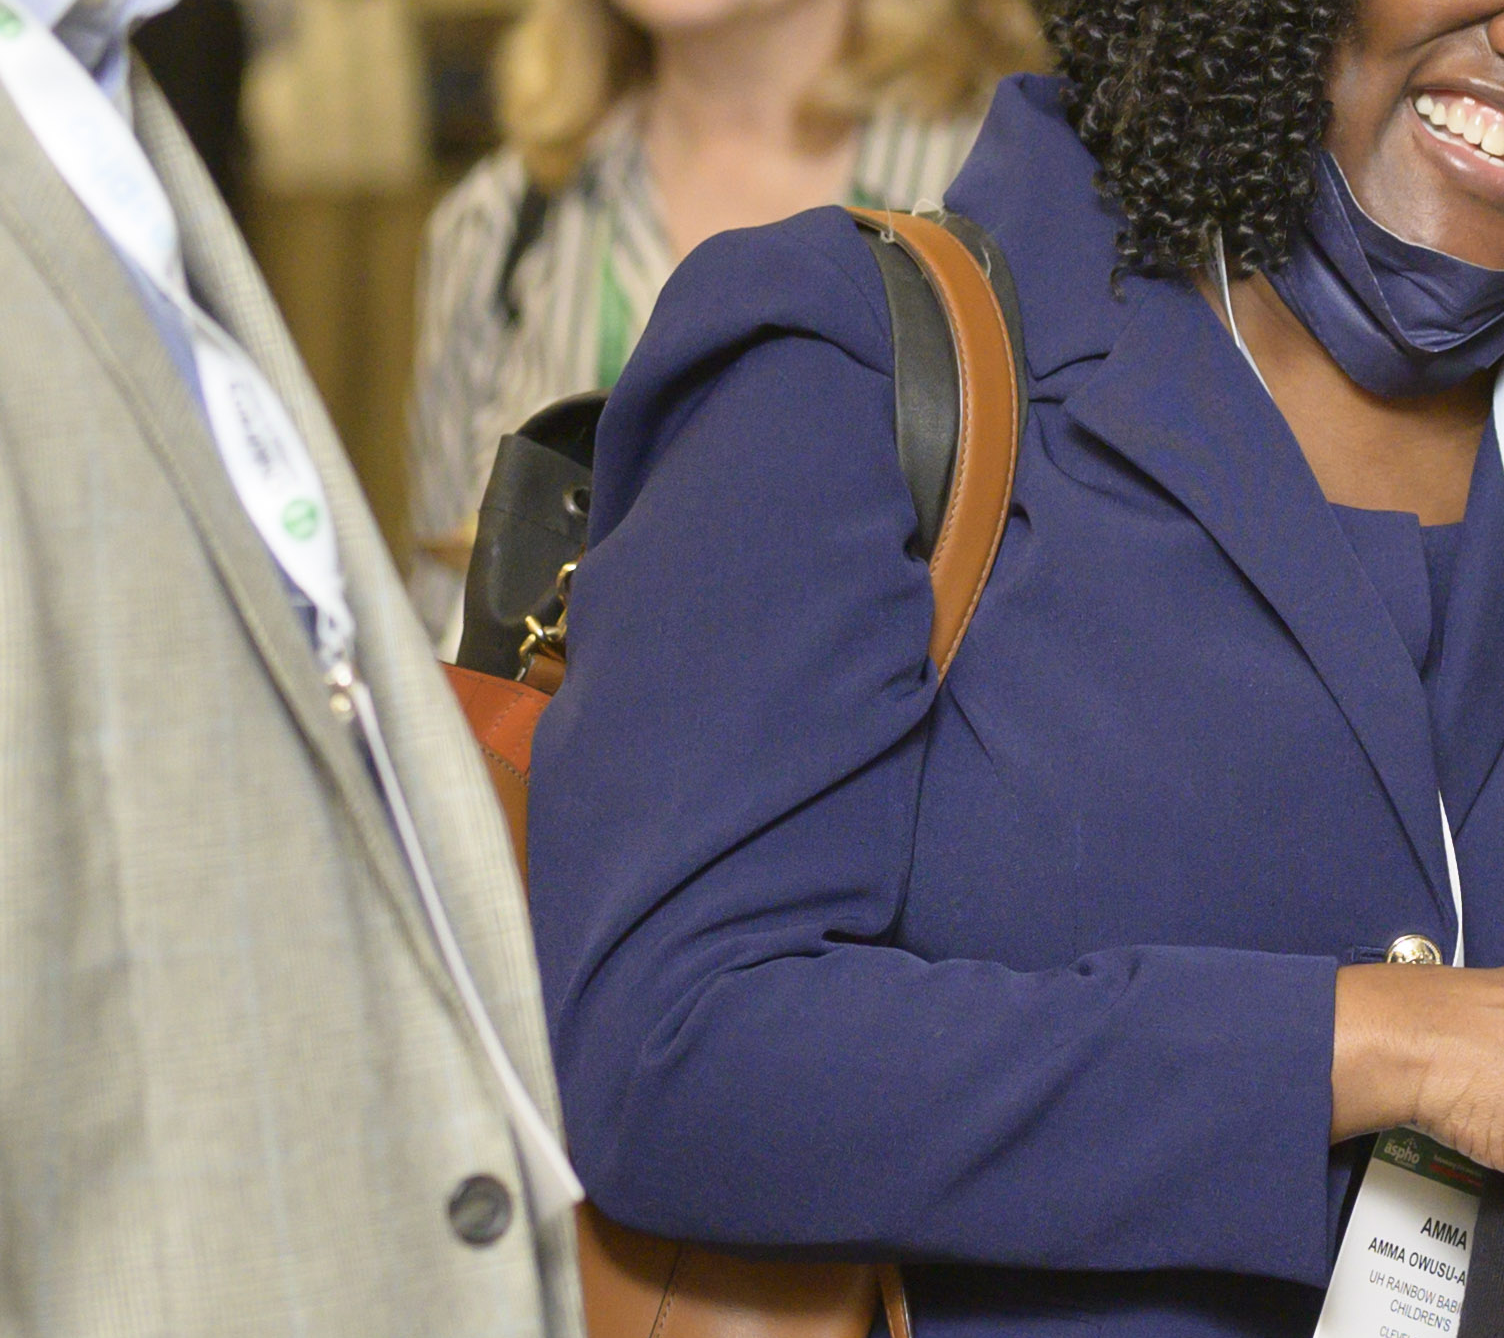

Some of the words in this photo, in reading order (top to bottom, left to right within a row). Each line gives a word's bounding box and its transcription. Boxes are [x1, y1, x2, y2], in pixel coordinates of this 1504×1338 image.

[1383, 1141, 1420, 1165] aspho
[1420, 1216, 1468, 1252] AMMA
[1367, 1236, 1406, 1264] AMMA
[1408, 1251, 1467, 1287] OWUSU-A
[1369, 1269, 1385, 1287] UH
[1385, 1275, 1436, 1305] RAINBOW
[1436, 1293, 1462, 1316] BABI
[1389, 1298, 1452, 1333] CHILDREN'S
